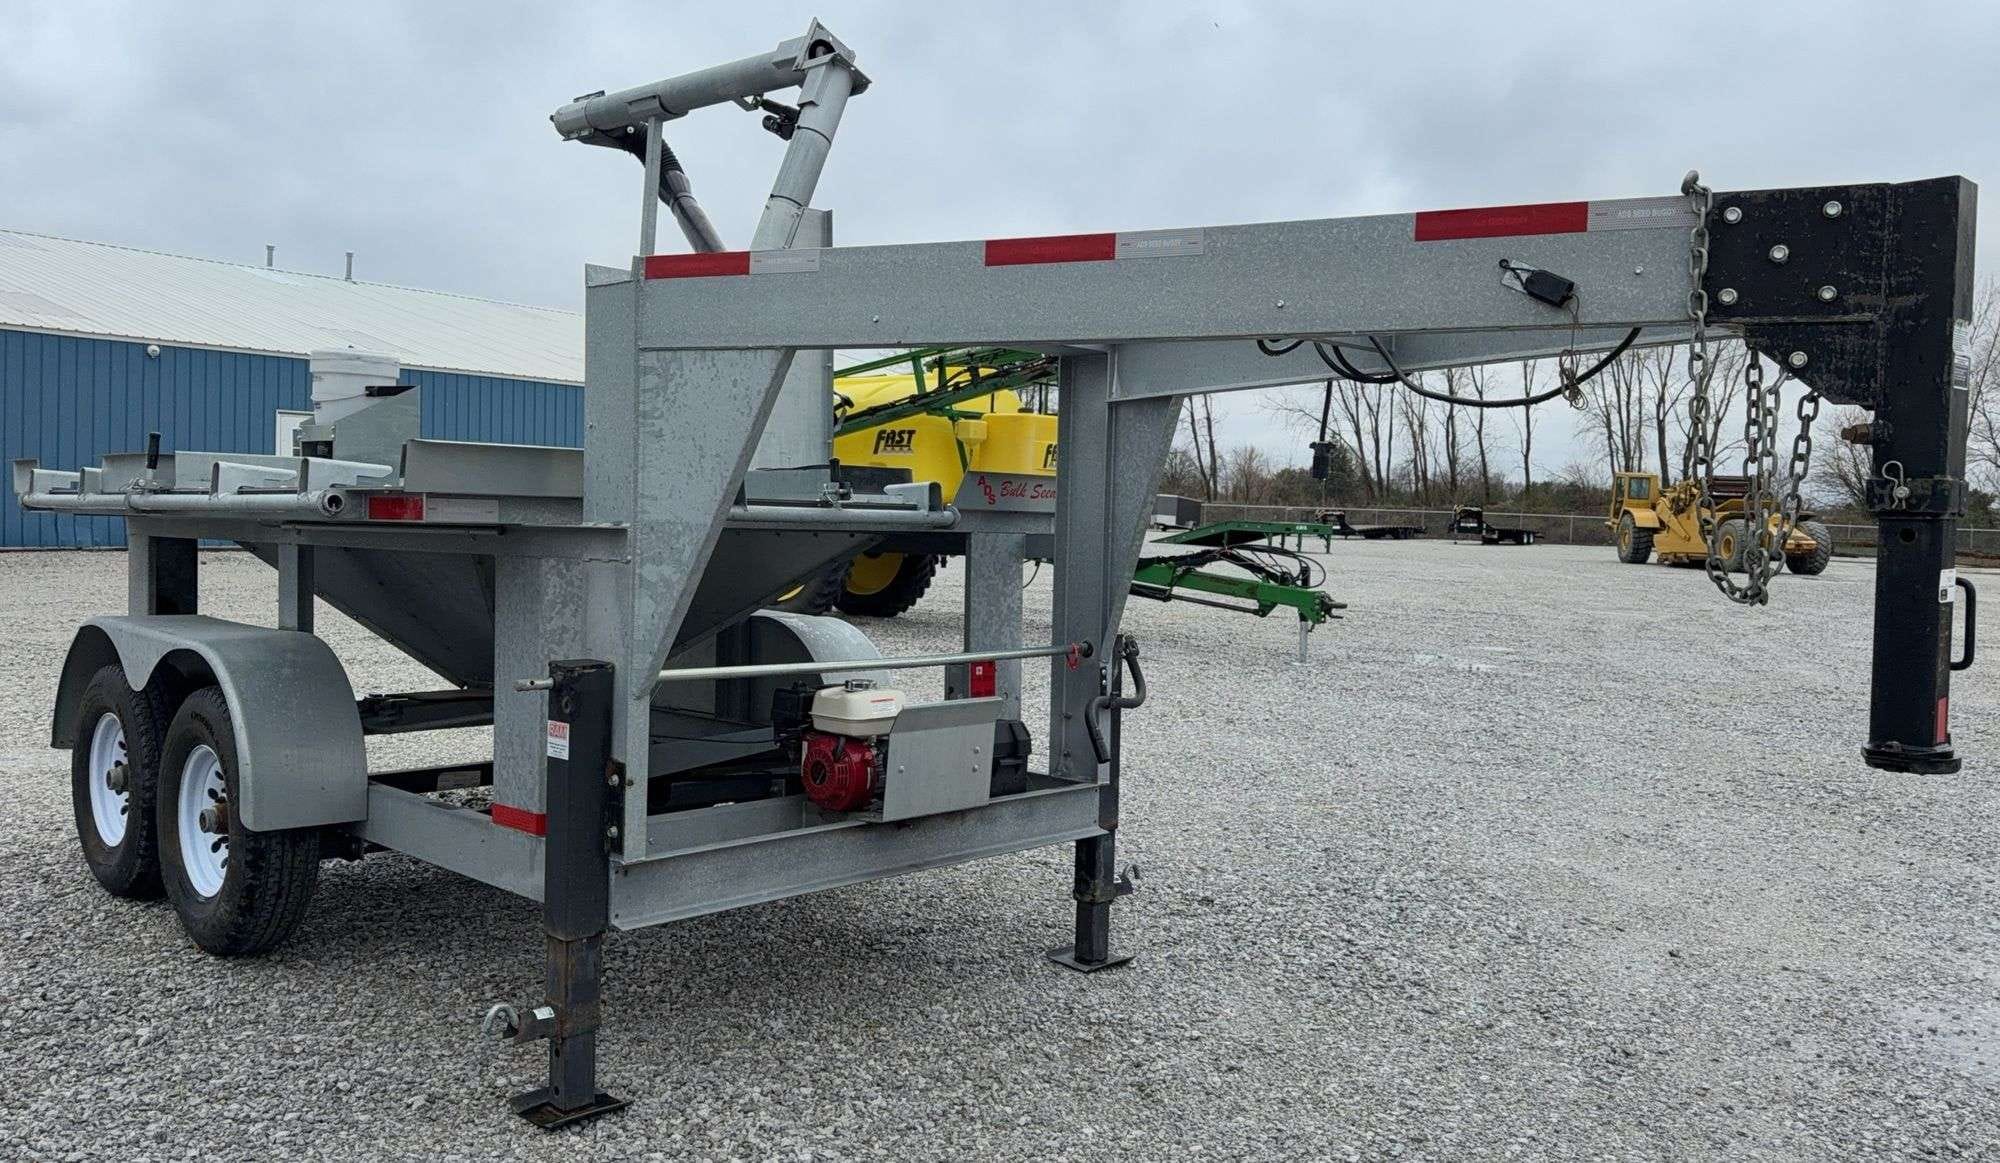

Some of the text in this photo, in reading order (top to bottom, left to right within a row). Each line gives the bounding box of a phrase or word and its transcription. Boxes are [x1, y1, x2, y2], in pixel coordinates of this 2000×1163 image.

[872, 429, 917, 455] FAST
[976, 475, 996, 505] ADS
[1000, 480, 1027, 498] Bulk
